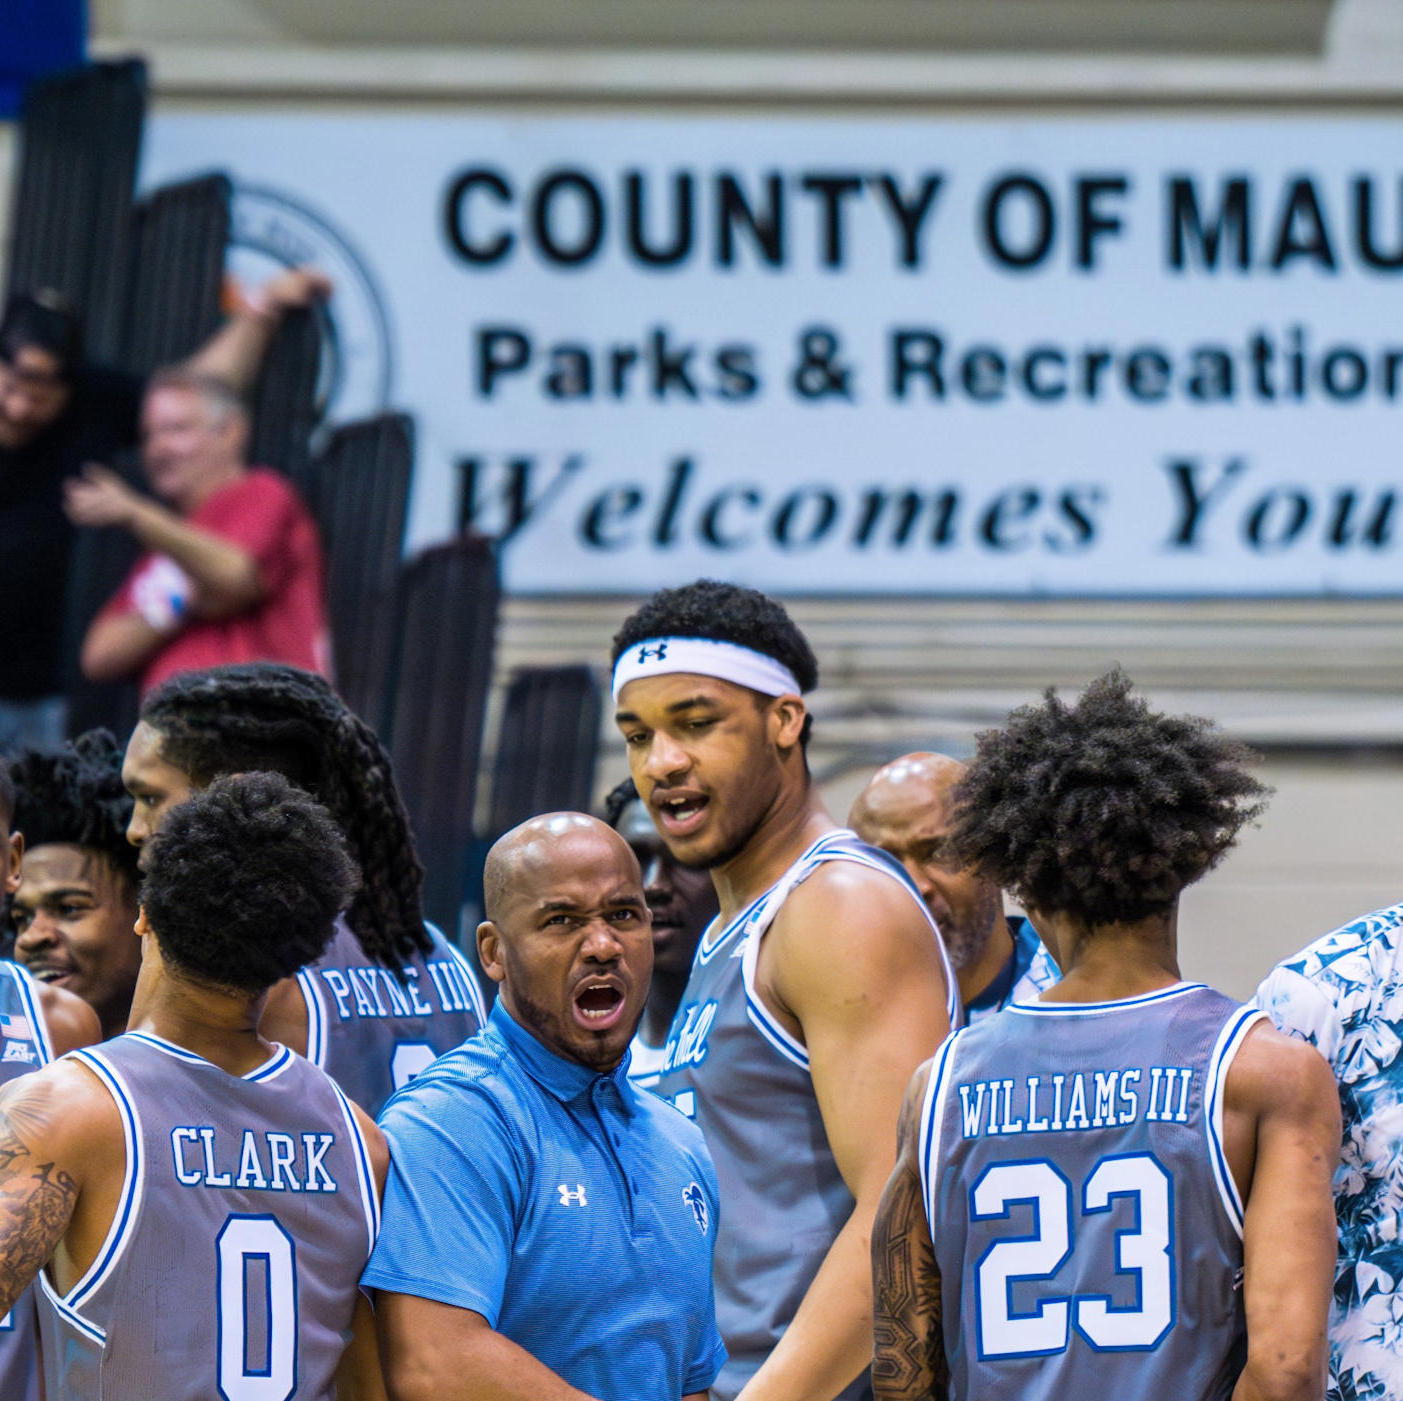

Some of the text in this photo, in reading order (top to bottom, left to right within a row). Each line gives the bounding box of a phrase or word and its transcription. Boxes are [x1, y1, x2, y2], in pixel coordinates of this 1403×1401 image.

[440, 168, 943, 275] COUNTY
[978, 169, 1130, 275] OF
[473, 324, 761, 402] Parks
[791, 324, 854, 402] &
[450, 452, 1107, 556] Welcomes
[321, 966, 433, 1019] PAYNE
[958, 1066, 1194, 1139] WILLIAMS III
[170, 1126, 338, 1193] CLARK
[968, 1151, 1178, 1362] 23
